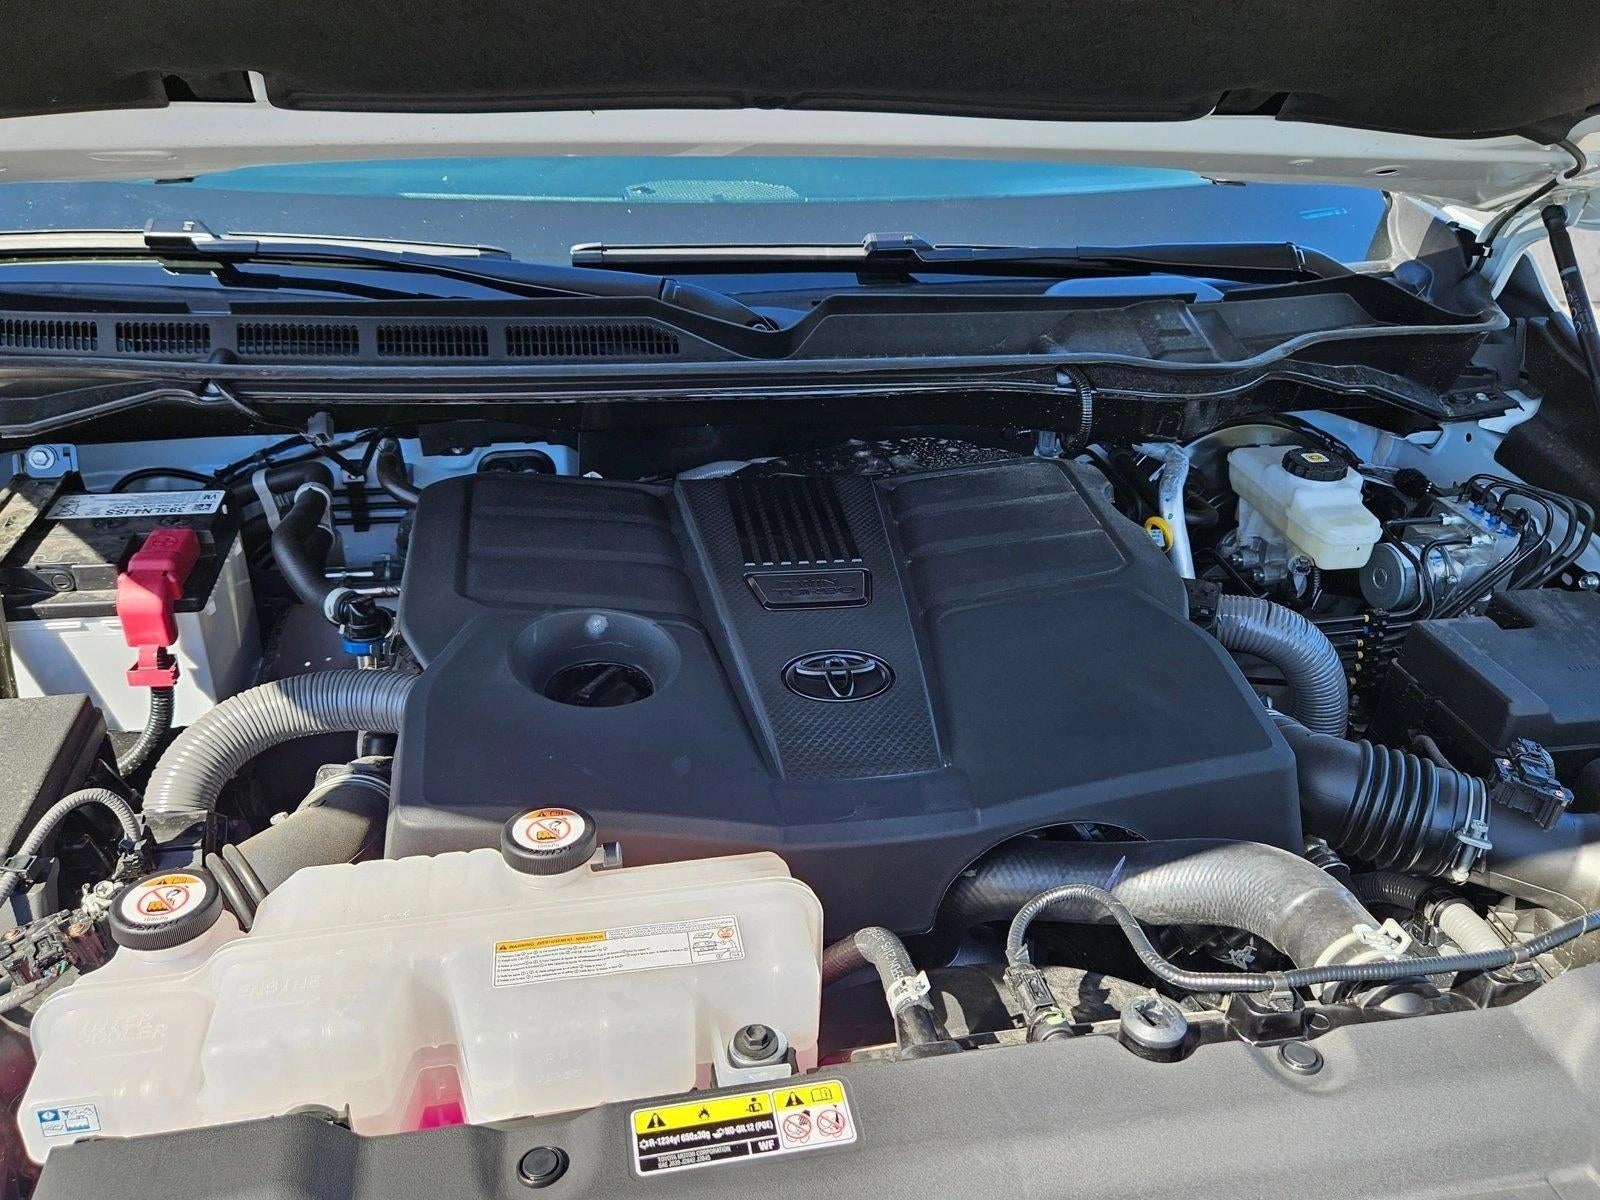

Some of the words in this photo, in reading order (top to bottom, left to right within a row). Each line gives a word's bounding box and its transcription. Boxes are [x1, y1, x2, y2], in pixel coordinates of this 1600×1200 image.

[757, 1139, 775, 1151] WF
[657, 1154, 678, 1163] TOYOTA
[677, 1151, 696, 1160] MOTOR
[696, 1145, 731, 1156] CORPORATION
